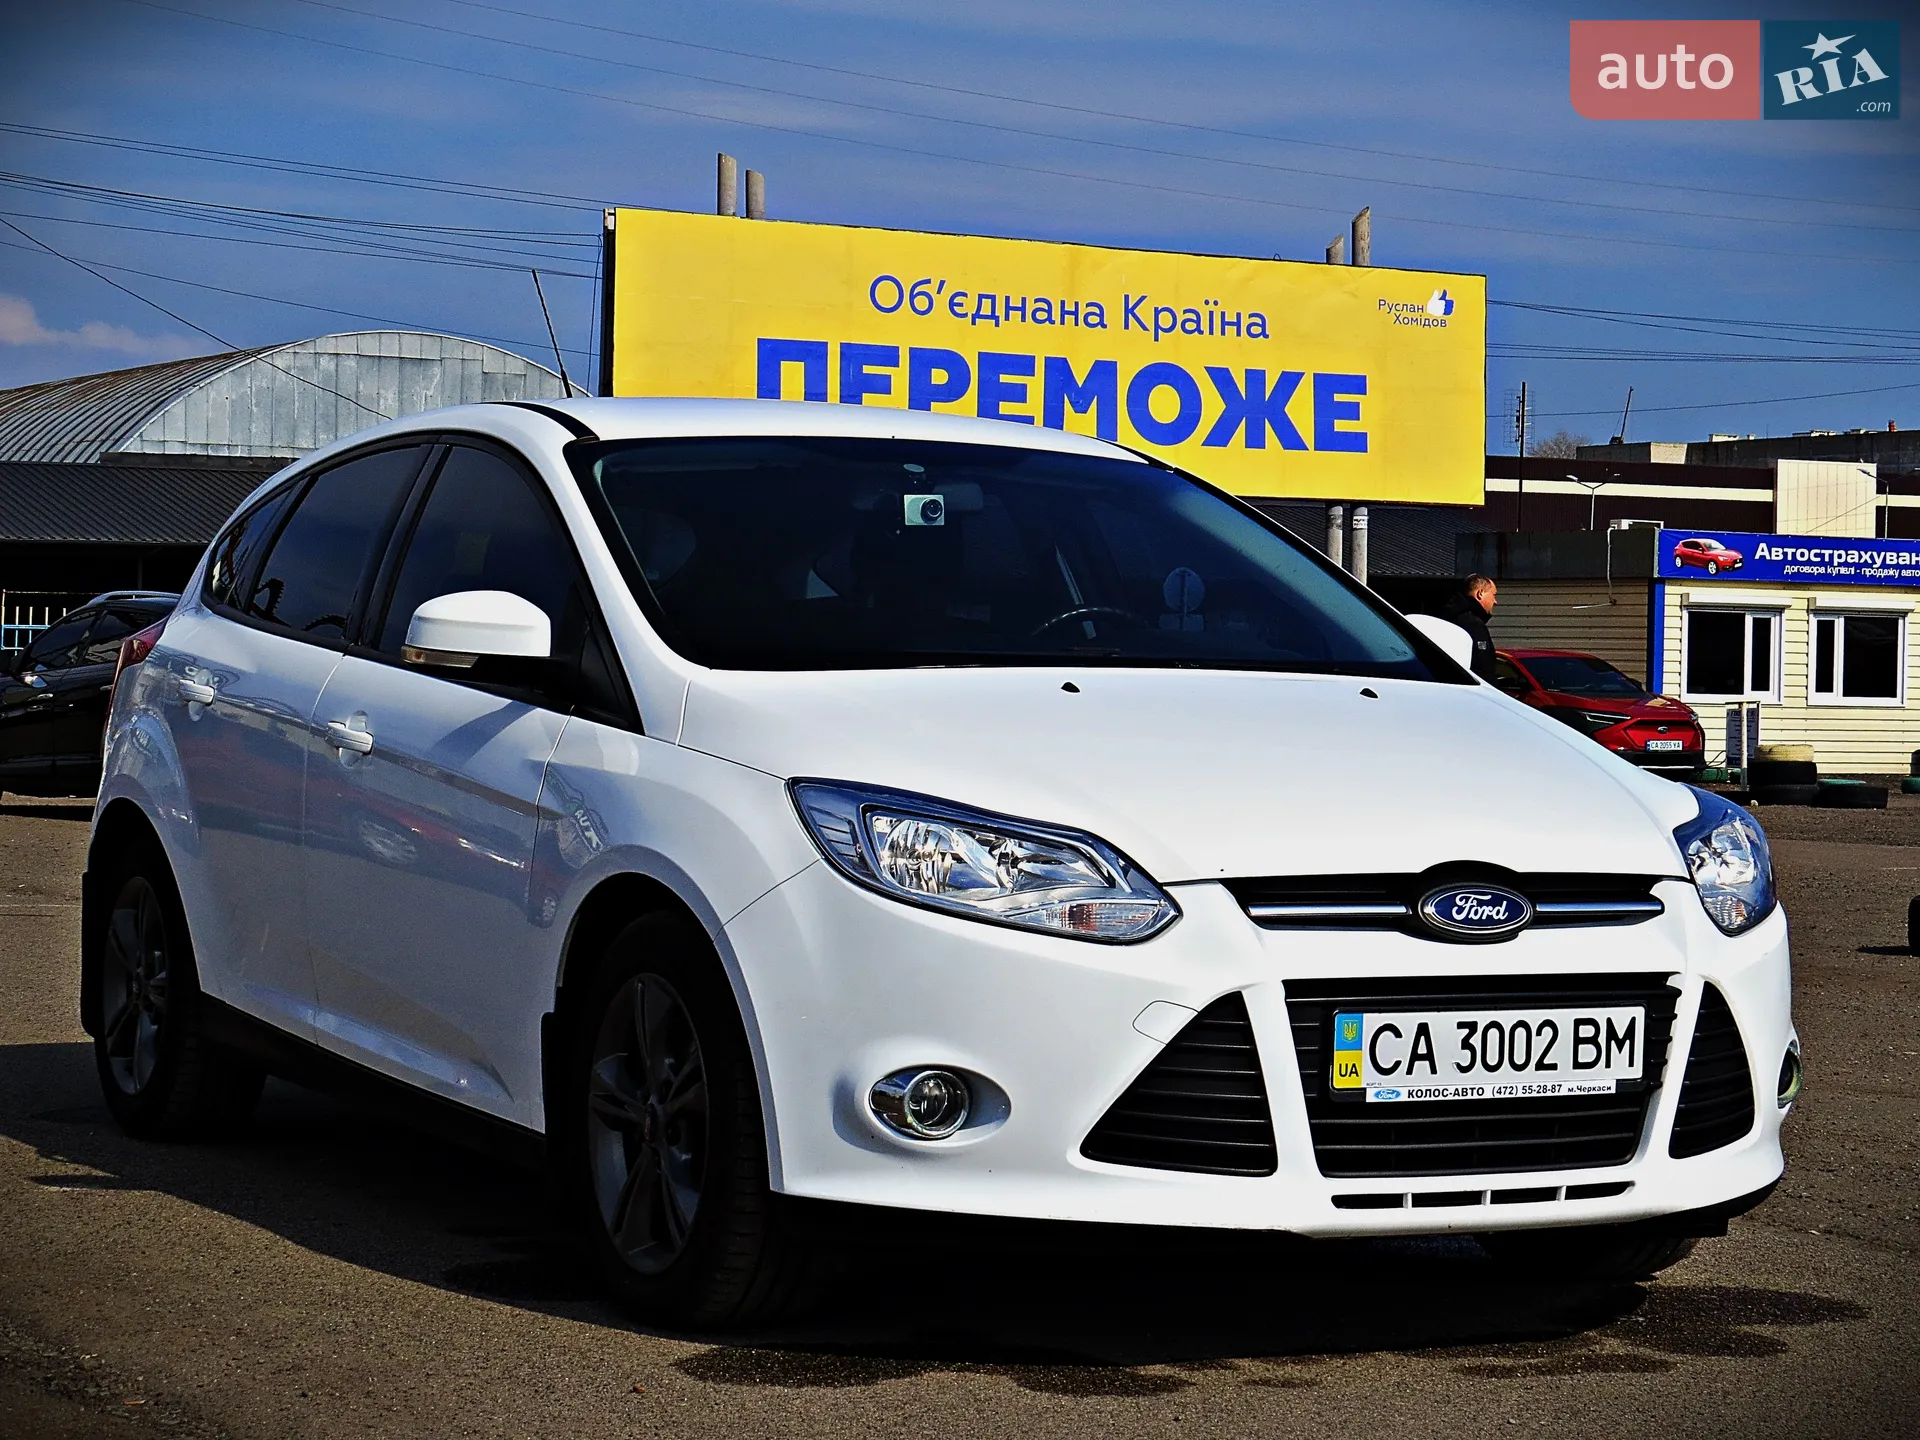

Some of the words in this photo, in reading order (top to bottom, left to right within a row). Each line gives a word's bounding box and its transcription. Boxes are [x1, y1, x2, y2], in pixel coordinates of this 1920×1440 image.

[869, 274, 1107, 328] Об'єднана
[1123, 293, 1269, 342] Країна
[1378, 299, 1424, 314] Руслан
[1393, 313, 1447, 328] Хомідов
[756, 337, 1369, 453] ПЕРЕМОЖЕ
[1784, 564, 1826, 576] договора
[1861, 567, 1900, 579] продажу
[1452, 893, 1508, 920] Ford
[1368, 1021, 1438, 1076] CA
[1452, 1018, 1559, 1074] 3002
[1572, 1016, 1637, 1070] BM
[1338, 1062, 1360, 1078] UA
[1378, 1088, 1397, 1100] Ford
[1407, 1086, 1485, 1099] КОЛОС-АВТО
[1491, 1085, 1518, 1098] (472)
[1521, 1083, 1563, 1095] 55-28-87
[1567, 1084, 1612, 1094] м.Черкаси
